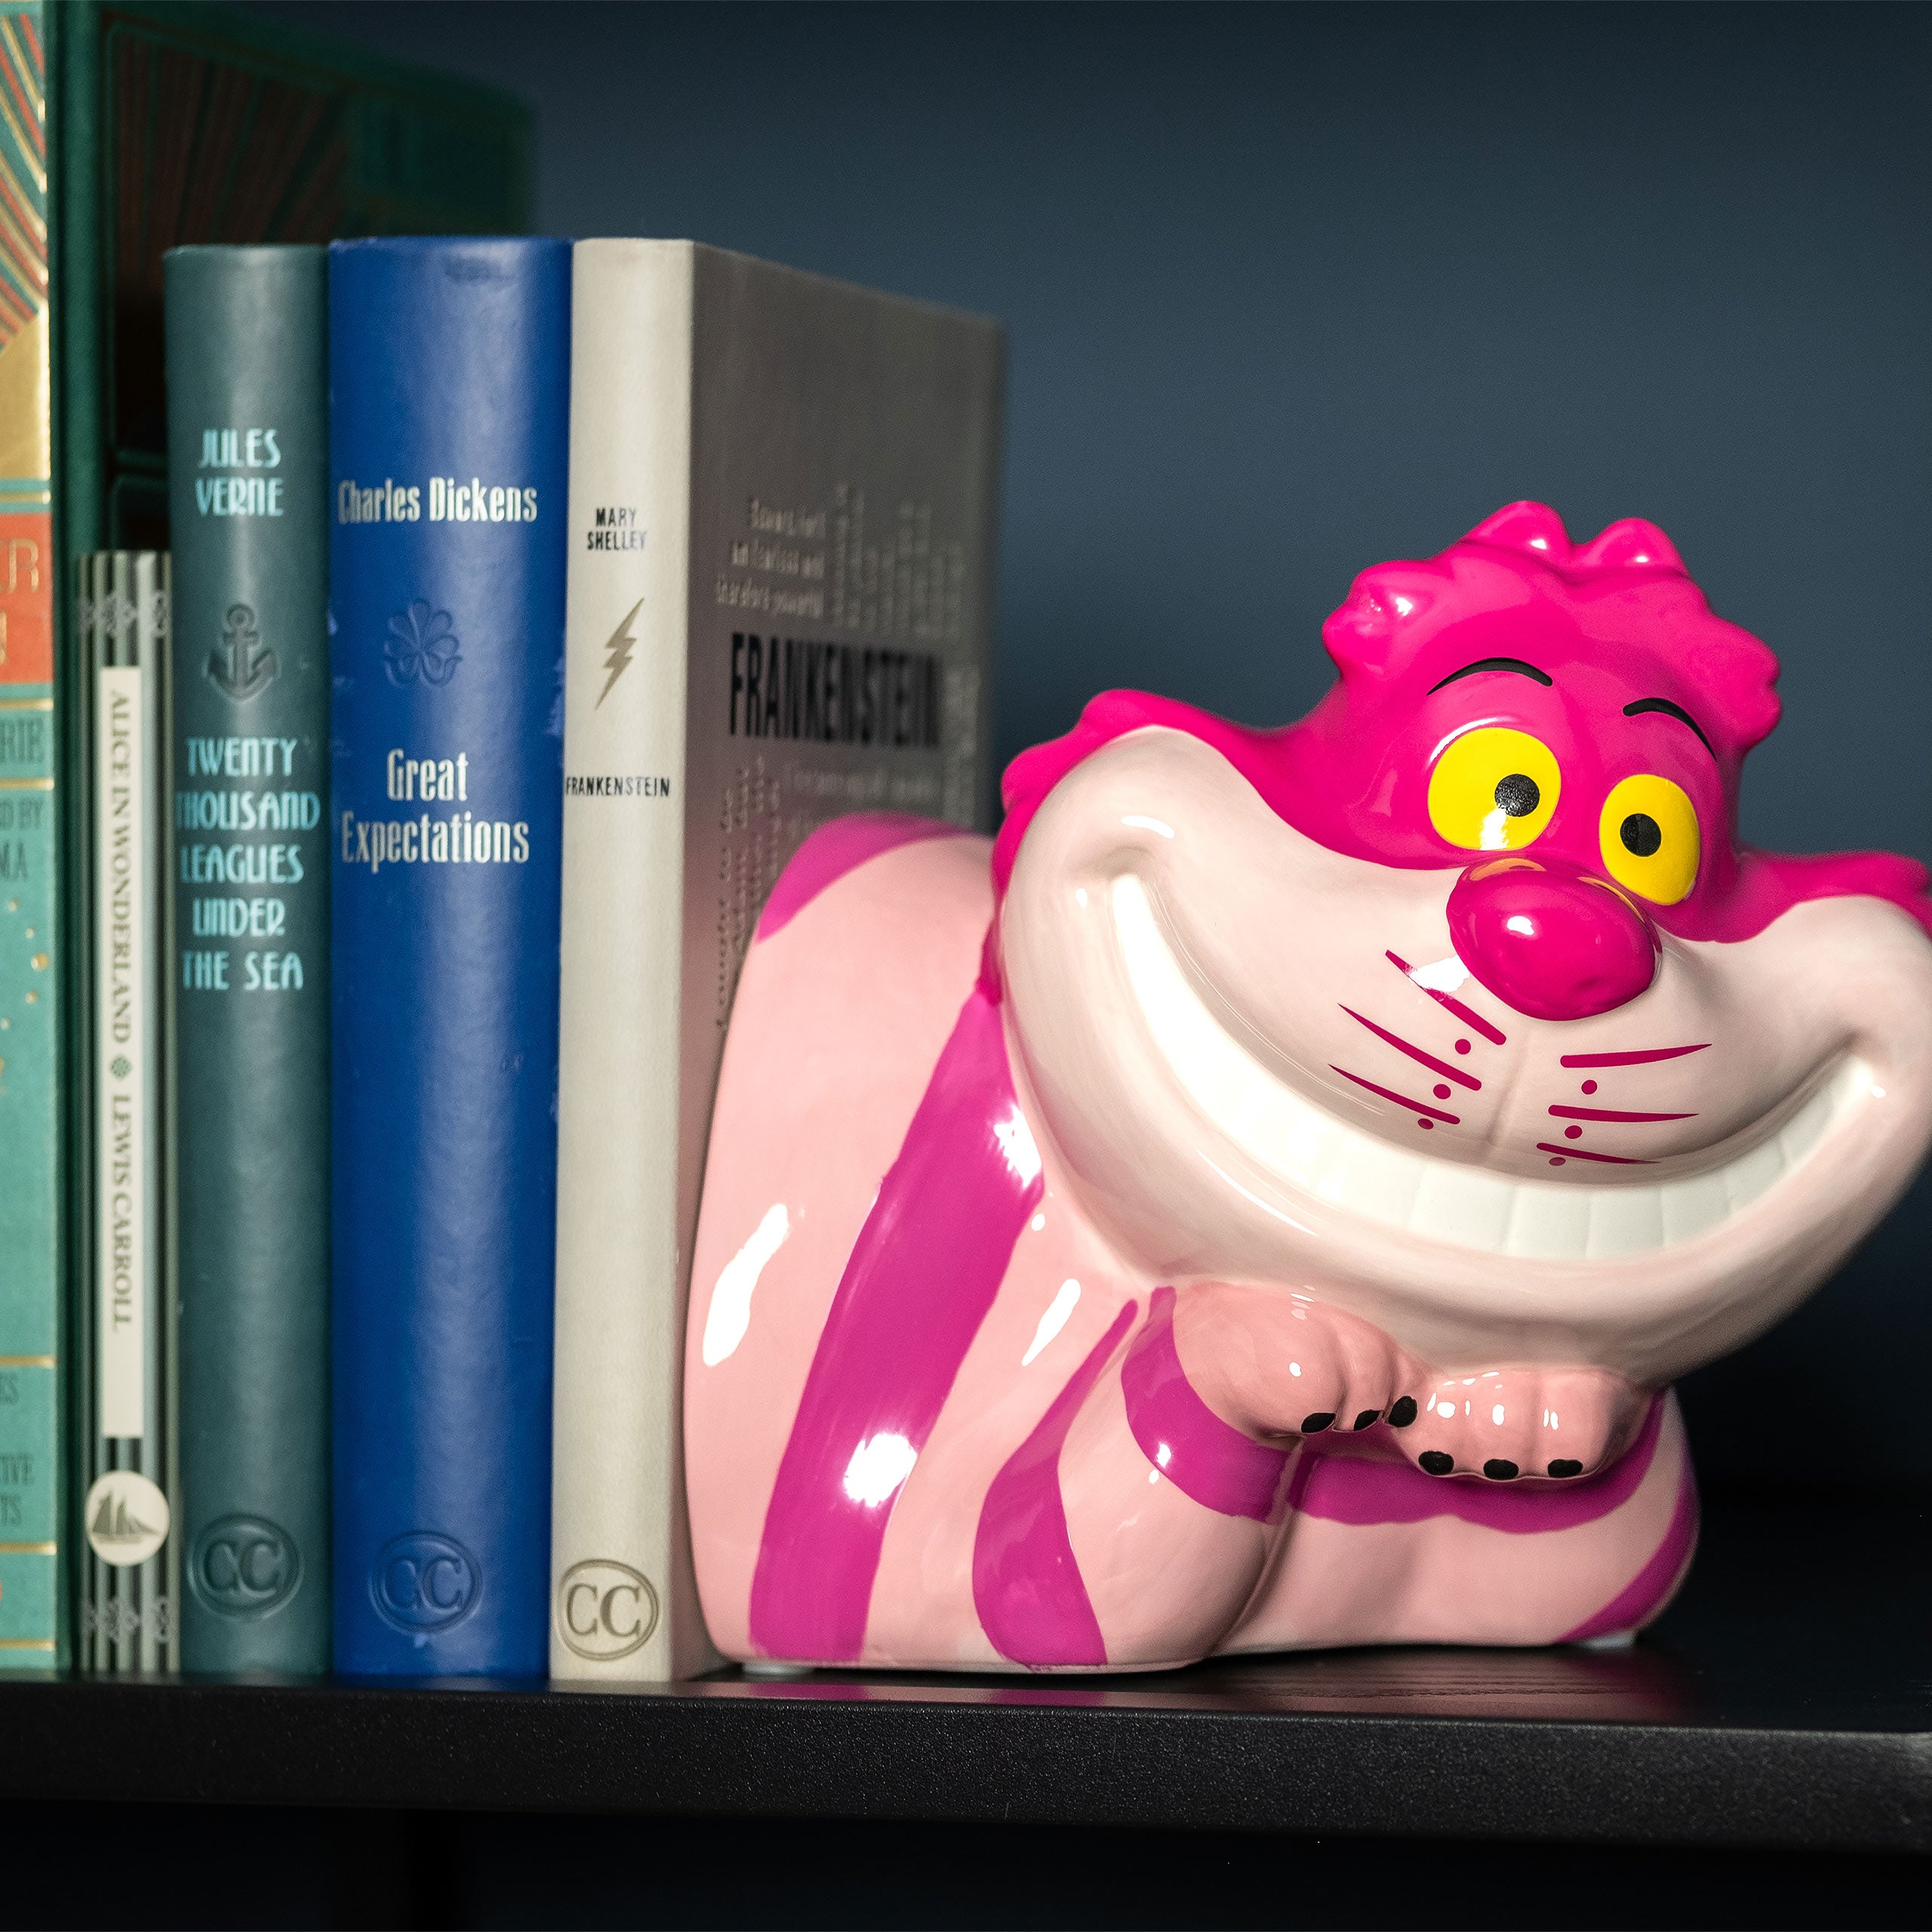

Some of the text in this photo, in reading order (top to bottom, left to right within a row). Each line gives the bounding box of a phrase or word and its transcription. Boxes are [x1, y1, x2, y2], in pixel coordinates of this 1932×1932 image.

[199, 429, 281, 468] JULES
[195, 478, 284, 517] VERNE
[338, 477, 537, 523] Charles Dickens
[595, 507, 637, 528] MARY
[586, 531, 647, 551] SHELLEY
[730, 632, 943, 749] FRANKENSTEIN
[186, 737, 297, 777] TWENTY
[387, 749, 469, 801] Great
[567, 777, 670, 797] FRANKENSTEIN
[175, 790, 321, 831] THOUSAND
[341, 811, 530, 874] Expectations
[181, 844, 304, 885] LEAGUES
[193, 898, 285, 937] UNDER
[183, 952, 303, 991] THE SEA
[111, 689, 133, 1333] ALICE IN WONDERLAND LEWIS CARROLL
[204, 1540, 281, 1598] CC
[383, 1555, 463, 1612] CC
[568, 1583, 641, 1637] CC
